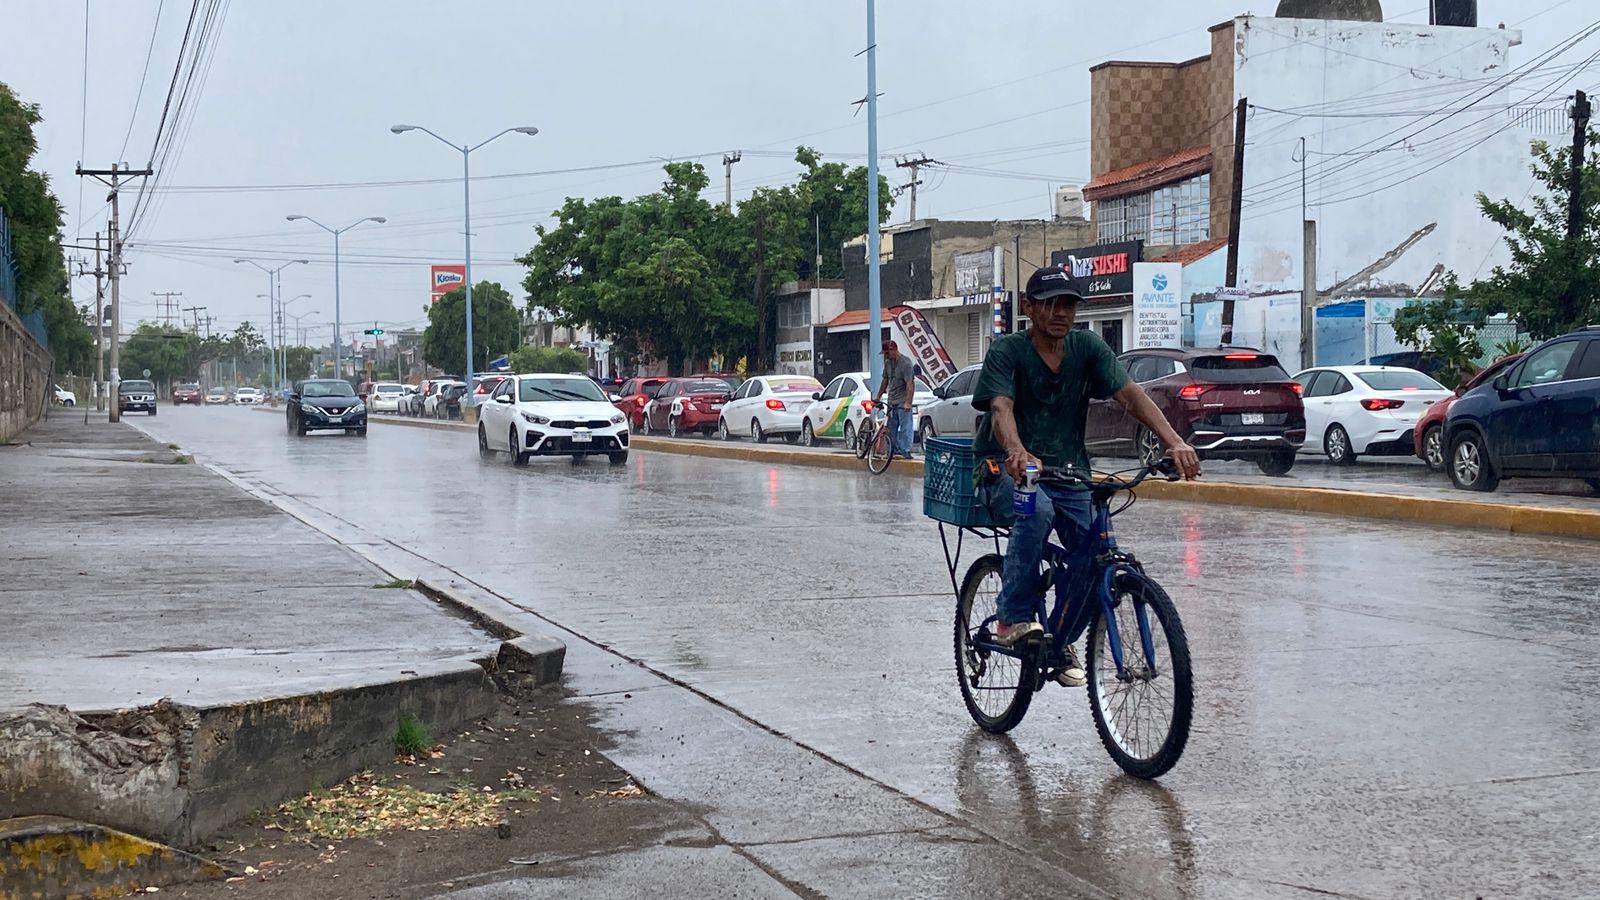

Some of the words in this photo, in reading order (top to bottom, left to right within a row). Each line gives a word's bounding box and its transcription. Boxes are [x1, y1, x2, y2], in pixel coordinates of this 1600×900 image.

[437, 274, 461, 283] Kiosko
[1141, 293, 1175, 303] AVANTE
[900, 312, 948, 383] BARBER
